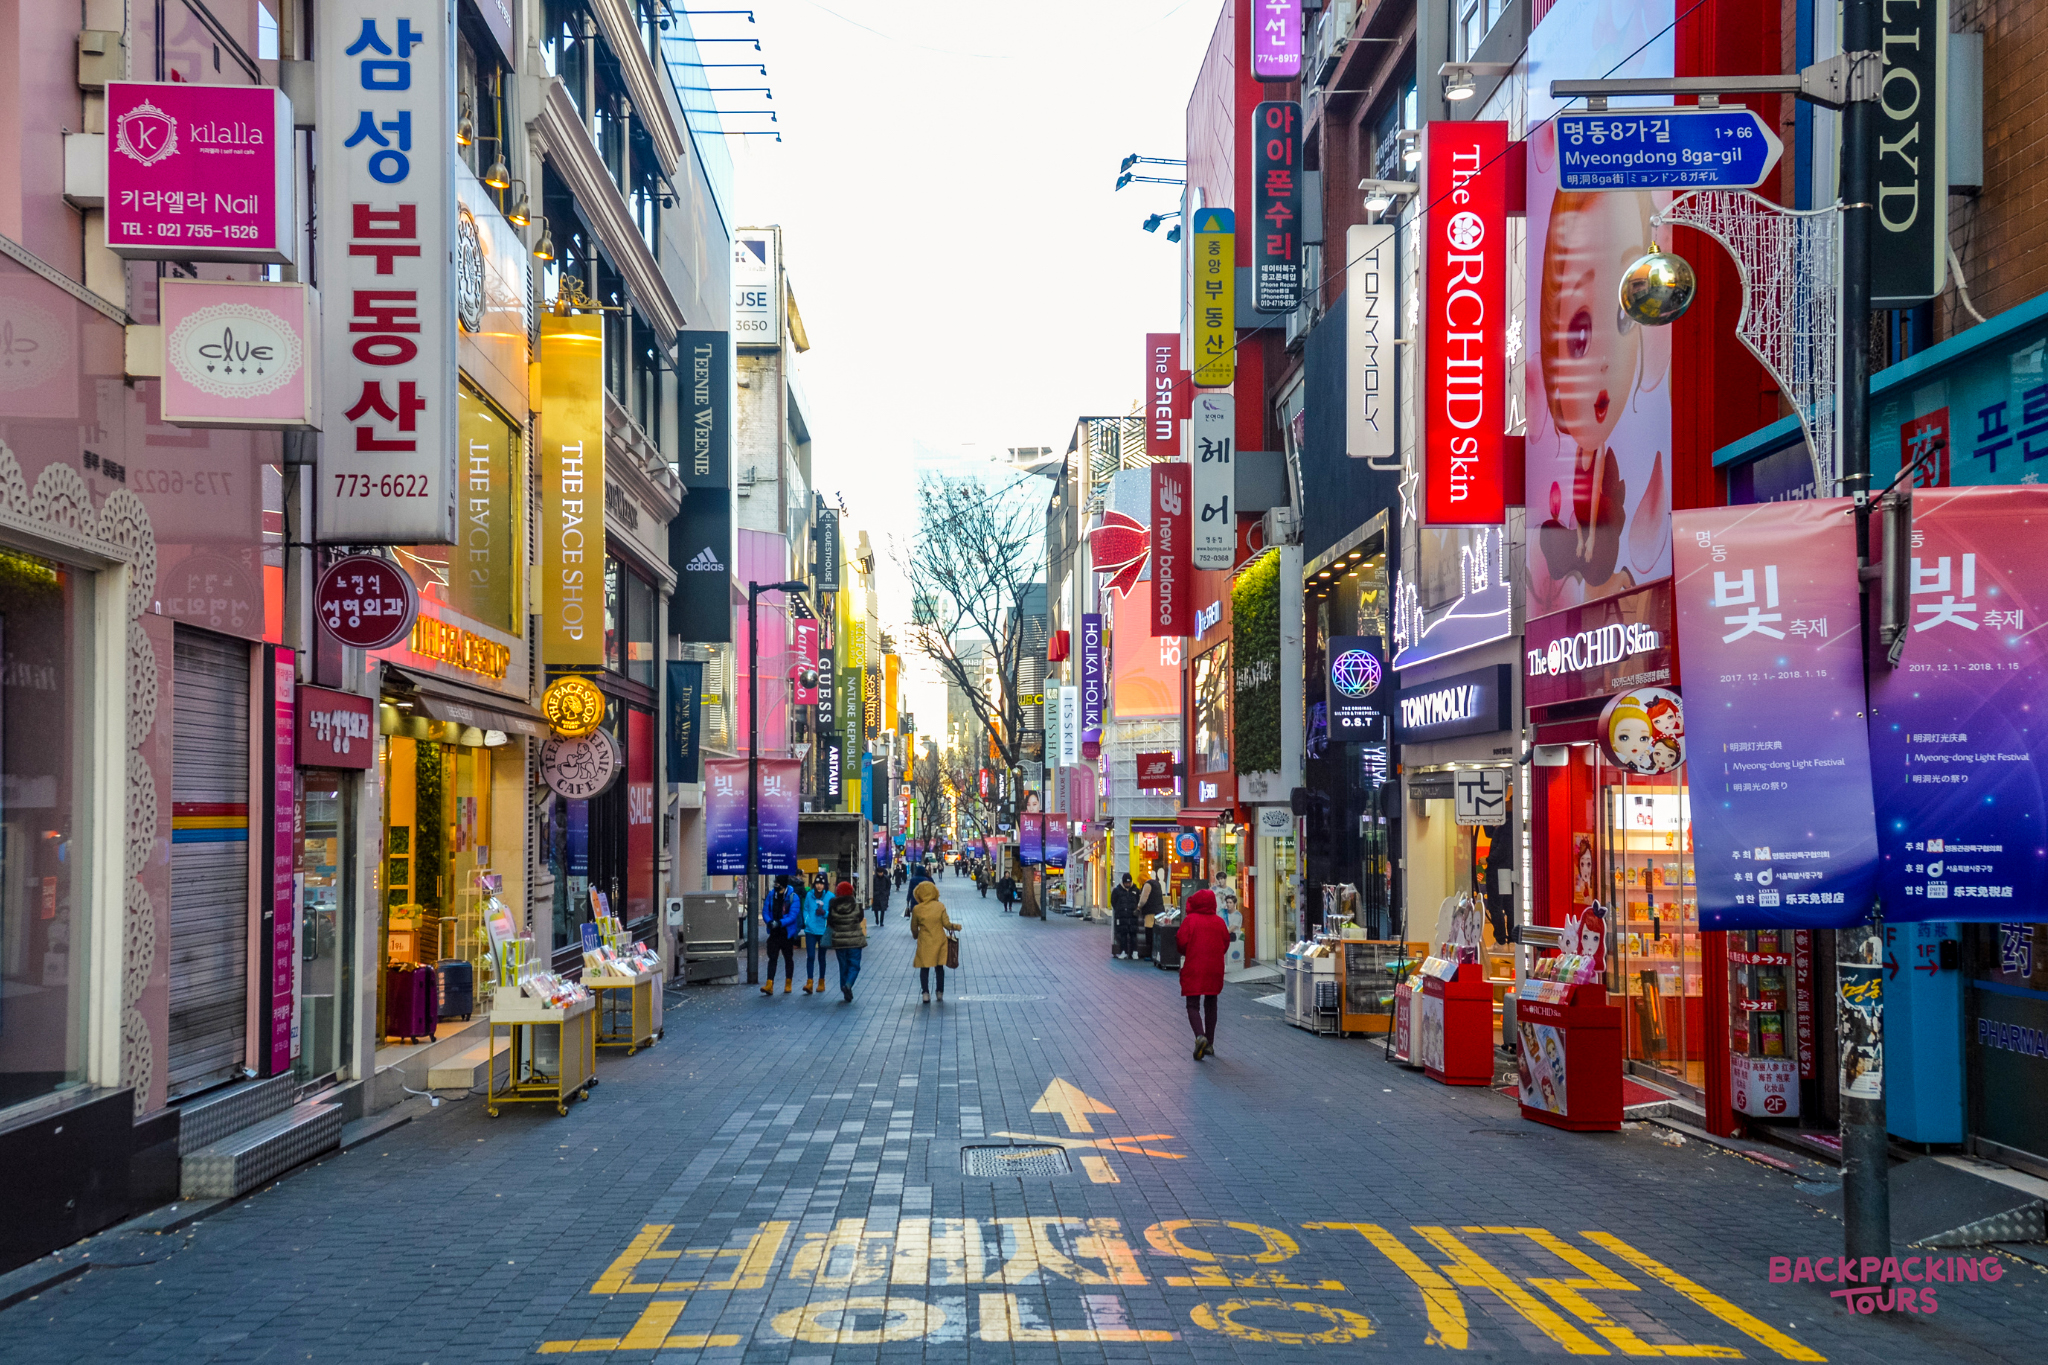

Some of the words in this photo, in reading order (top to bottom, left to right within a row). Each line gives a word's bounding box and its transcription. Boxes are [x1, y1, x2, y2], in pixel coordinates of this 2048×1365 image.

[1257, 54, 1299, 63] 774-8917
[190, 121, 264, 145] kilalla
[1563, 119, 1670, 146] 명동8가길
[1736, 126, 1753, 139] 66
[1452, 144, 1480, 205] The
[1565, 150, 1677, 168] Myeongdong
[1682, 147, 1742, 165] 8ga-gil
[1264, 106, 1294, 260] 아이폰수리
[121, 190, 208, 214] 키라엘라
[214, 194, 258, 214] Nail
[121, 222, 143, 236] TEL
[186, 224, 259, 239] 755-1526
[1446, 211, 1485, 430] ORCHID
[198, 326, 274, 363] clue
[1364, 248, 1379, 431] TONYMOLY
[694, 343, 713, 406] TEENIE
[1155, 346, 1172, 374] the
[1155, 376, 1172, 441] SAEM
[693, 406, 713, 476] WEENIE
[561, 439, 584, 494] THE
[1197, 437, 1230, 525] 헤어
[1450, 437, 1480, 503] Skin
[334, 473, 429, 499] 773-6622
[561, 498, 584, 564] FACE
[1160, 517, 1172, 552] new
[686, 556, 724, 572] adidas
[824, 523, 833, 583] K-GUESTHOUSE
[1199, 554, 1229, 562] 752-0368
[561, 568, 584, 641] SHOP
[1159, 557, 1172, 626] balance
[1712, 564, 1787, 645] 빛
[1788, 616, 1829, 639] 축제
[1910, 553, 1980, 634] 빛
[1982, 609, 2024, 630] 축제
[322, 598, 404, 628] 성형외과
[1085, 622, 1099, 676] HOLIKA
[1527, 648, 1548, 677] The
[1547, 622, 1627, 677] ORCHID
[1626, 622, 1660, 656] Skin
[2008, 662, 2020, 670] 15
[818, 657, 832, 723] GUESS
[1816, 669, 1828, 677] 15
[554, 683, 584, 700] FACE
[581, 690, 596, 724] SHOP
[682, 685, 693, 719] TEENIE
[847, 676, 857, 718] NATURE
[1085, 679, 1099, 732] HOLIKA
[1400, 684, 1474, 728] TONYMOLY
[548, 695, 562, 723] THE
[1341, 717, 1373, 727] O.S.T
[680, 721, 691, 758] WEENIE
[847, 721, 857, 770] REPUBLIC
[1048, 703, 1057, 759] MISSHA
[828, 745, 839, 796] ARITAUM
[1732, 759, 1788, 772] Myeong-dong
[1789, 758, 1811, 770] Light
[1812, 757, 1845, 768] Festival
[1914, 752, 1973, 764] Myeong-dong
[1975, 752, 1996, 764] Light
[1997, 752, 2030, 762] Festival
[556, 778, 597, 795] CAFE
[713, 774, 734, 797] 빛
[763, 774, 781, 797] 빛
[629, 785, 652, 825] SALE
[1785, 892, 1845, 905] 乐天免税店
[1953, 886, 2013, 898] 乐天免税店
[584, 933, 599, 952] SALE
[1917, 944, 1936, 958] 1F
[1776, 956, 1788, 965] 2F
[1760, 1001, 1774, 1010] 2F
[1766, 1097, 1784, 1111] 2F
